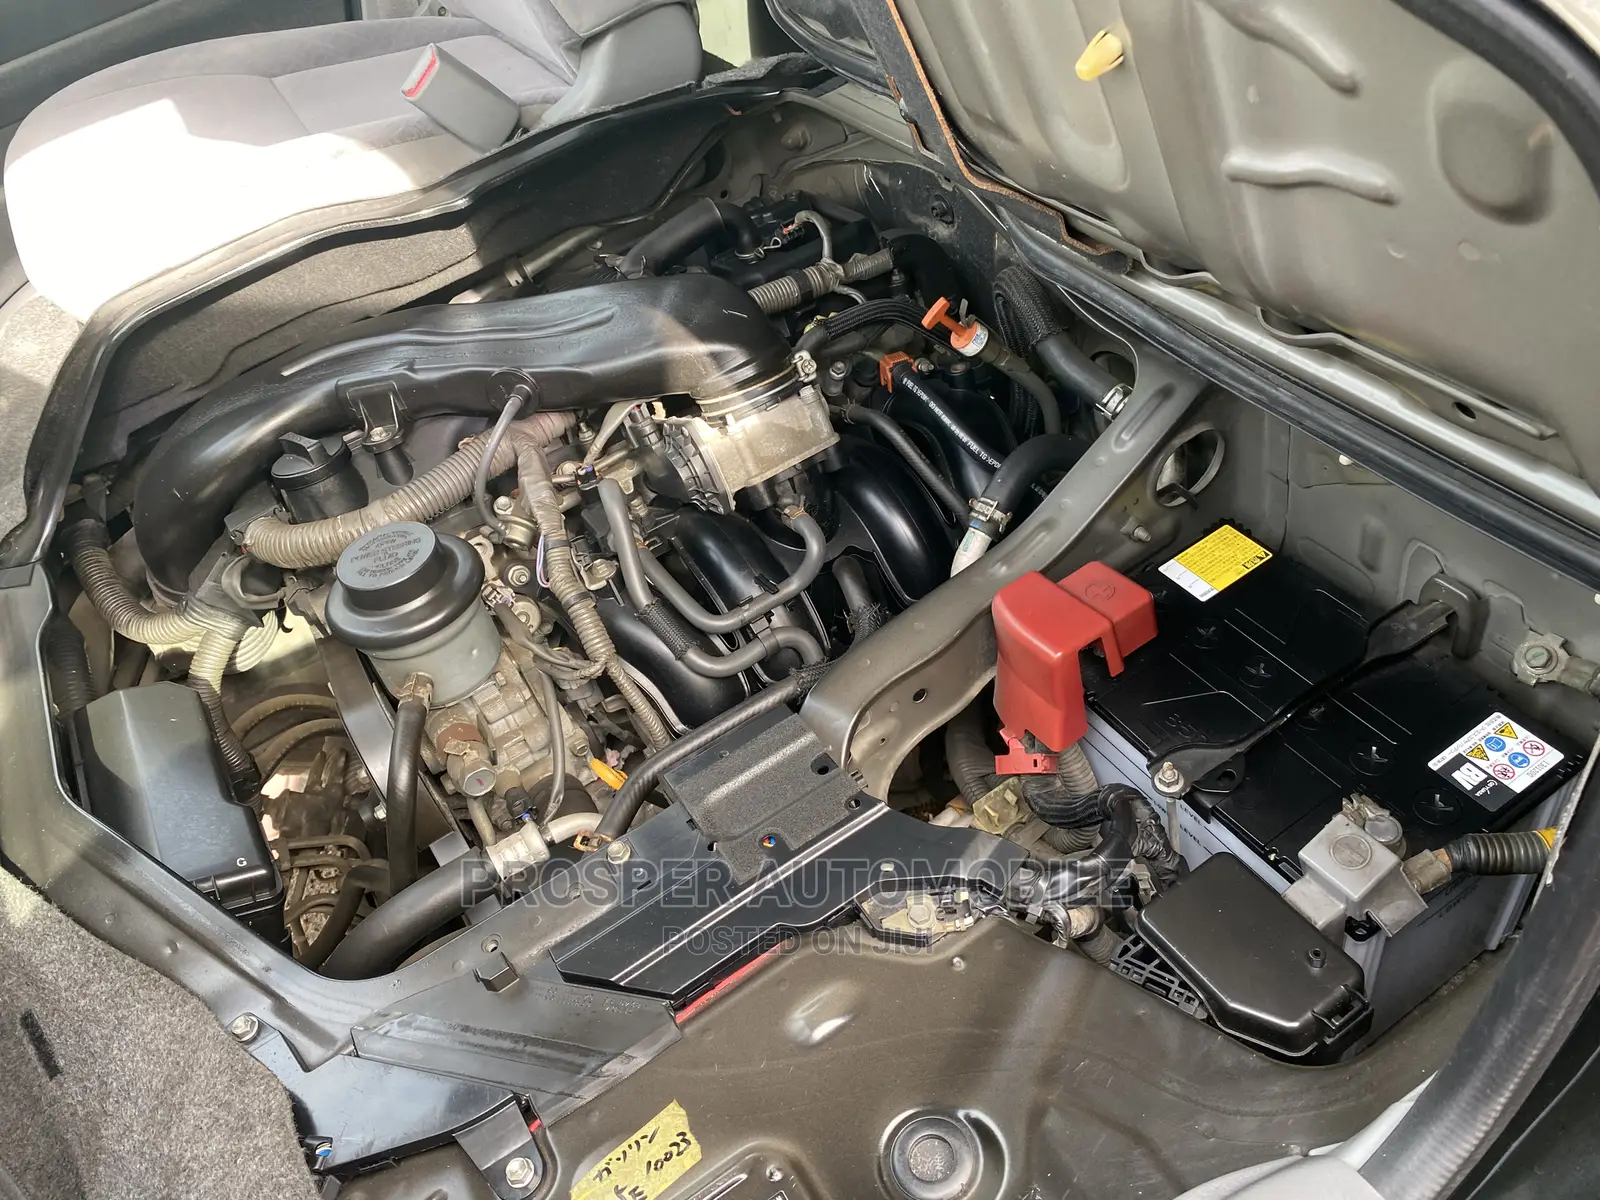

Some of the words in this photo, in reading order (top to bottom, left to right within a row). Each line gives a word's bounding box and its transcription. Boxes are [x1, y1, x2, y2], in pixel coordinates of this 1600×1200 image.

[967, 439, 980, 455] FUEL
[1451, 762, 1488, 791] BV
[235, 857, 247, 867] G
[645, 1131, 692, 1175] 10023
